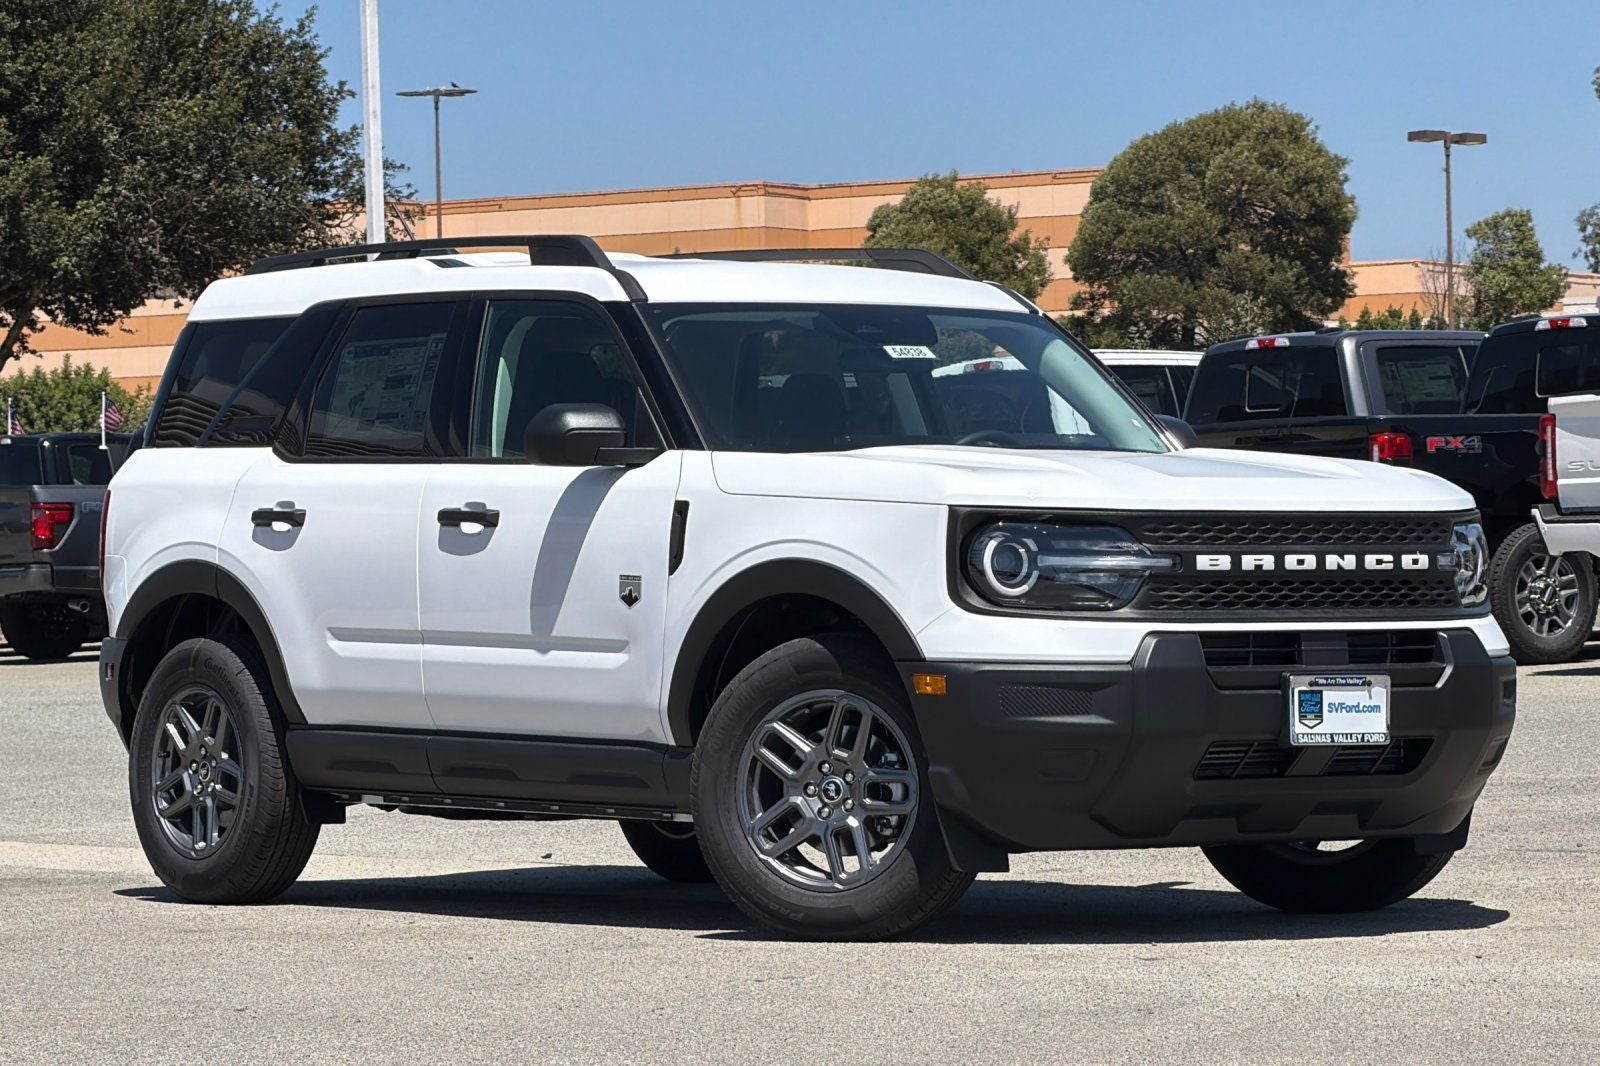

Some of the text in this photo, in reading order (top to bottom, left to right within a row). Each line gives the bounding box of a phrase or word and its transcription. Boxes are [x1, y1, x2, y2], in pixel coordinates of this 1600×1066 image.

[1426, 436, 1482, 452] FX4
[1196, 554, 1429, 571] BRONCO
[1300, 701, 1321, 713] Ford
[1327, 702, 1381, 714] SVFord.com
[1333, 733, 1363, 743] VALLEY
[1364, 733, 1386, 743] FORD
